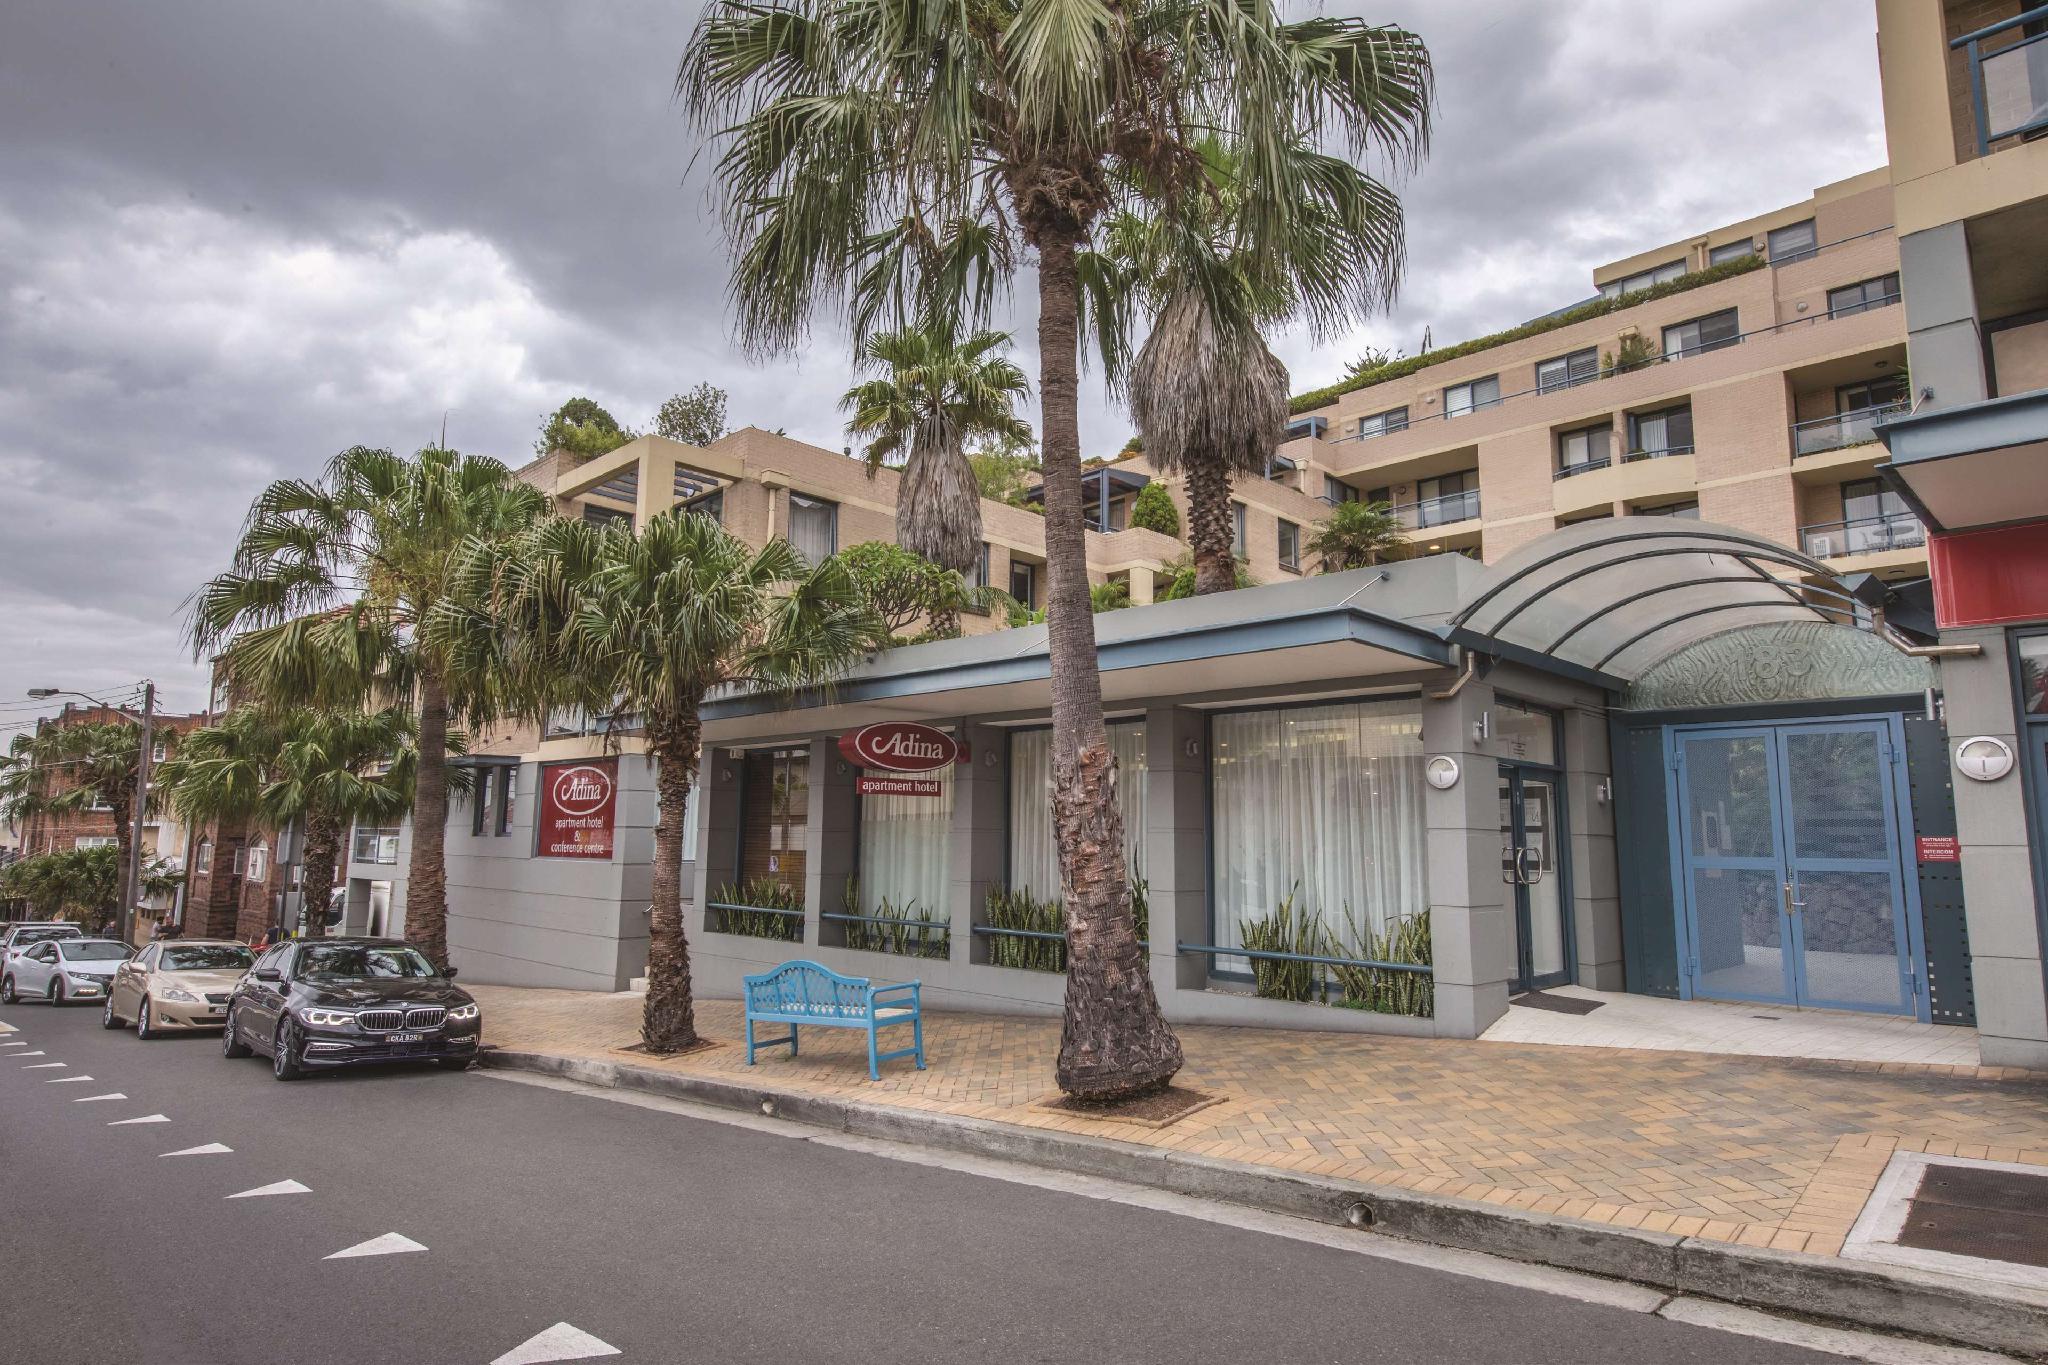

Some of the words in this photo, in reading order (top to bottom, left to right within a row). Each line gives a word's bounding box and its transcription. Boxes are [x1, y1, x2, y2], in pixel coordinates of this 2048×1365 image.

[871, 732, 944, 759] Adina
[562, 778, 601, 801] Adina
[862, 780, 912, 793] apartment
[914, 781, 938, 792] hotel
[555, 817, 585, 829] apartment
[587, 816, 604, 828] hotel
[574, 830, 581, 841] &
[551, 841, 583, 853] conference
[584, 842, 604, 854] centre
